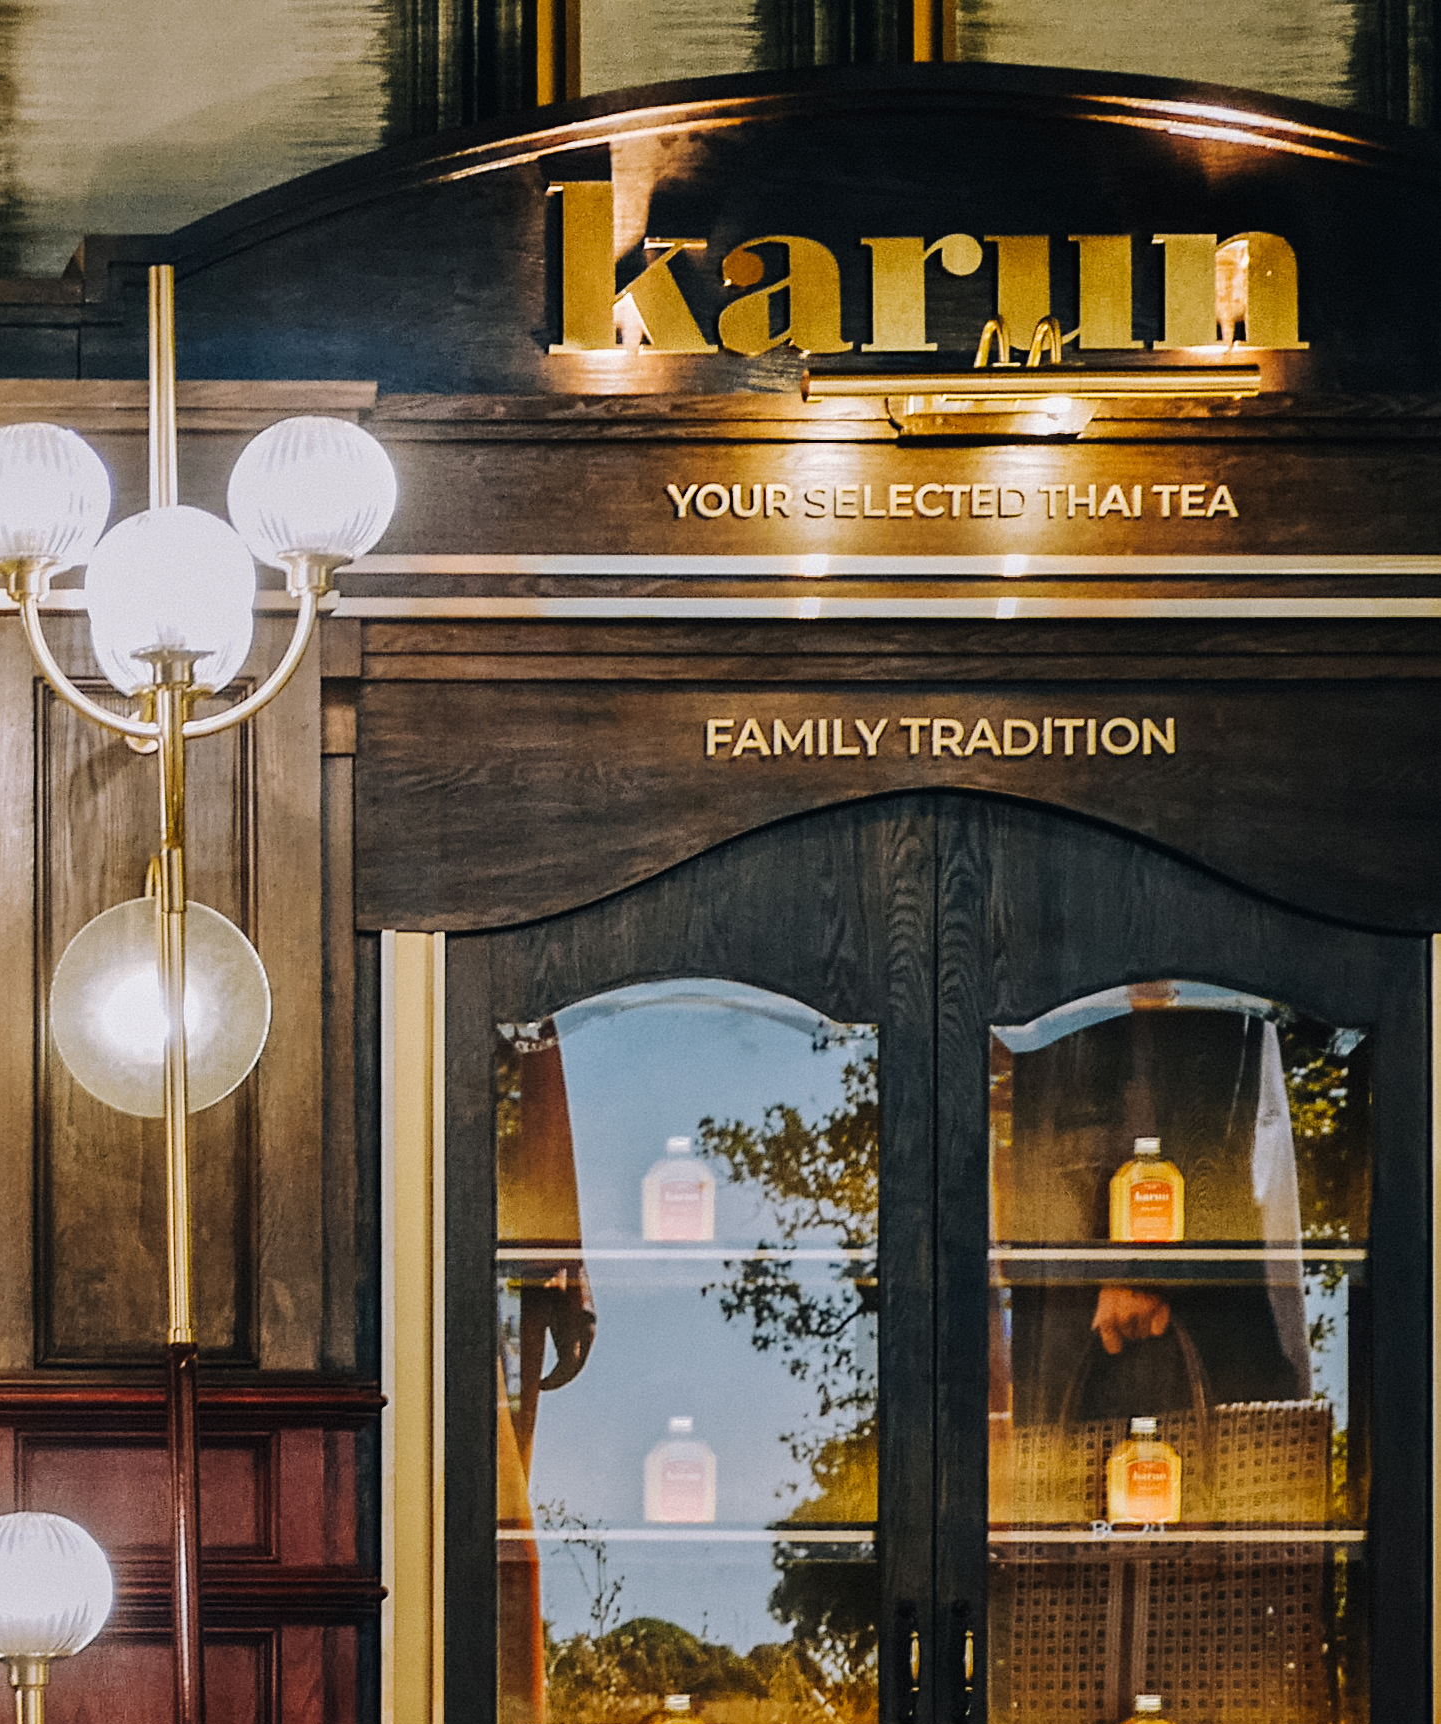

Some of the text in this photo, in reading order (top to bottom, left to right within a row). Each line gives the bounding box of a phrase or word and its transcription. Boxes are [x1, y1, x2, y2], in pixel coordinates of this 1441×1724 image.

[548, 180, 1310, 355] karun
[667, 483, 1239, 519] YOUR SELECTED THAI TEA
[706, 716, 1176, 757] FAMILY TRADITION
